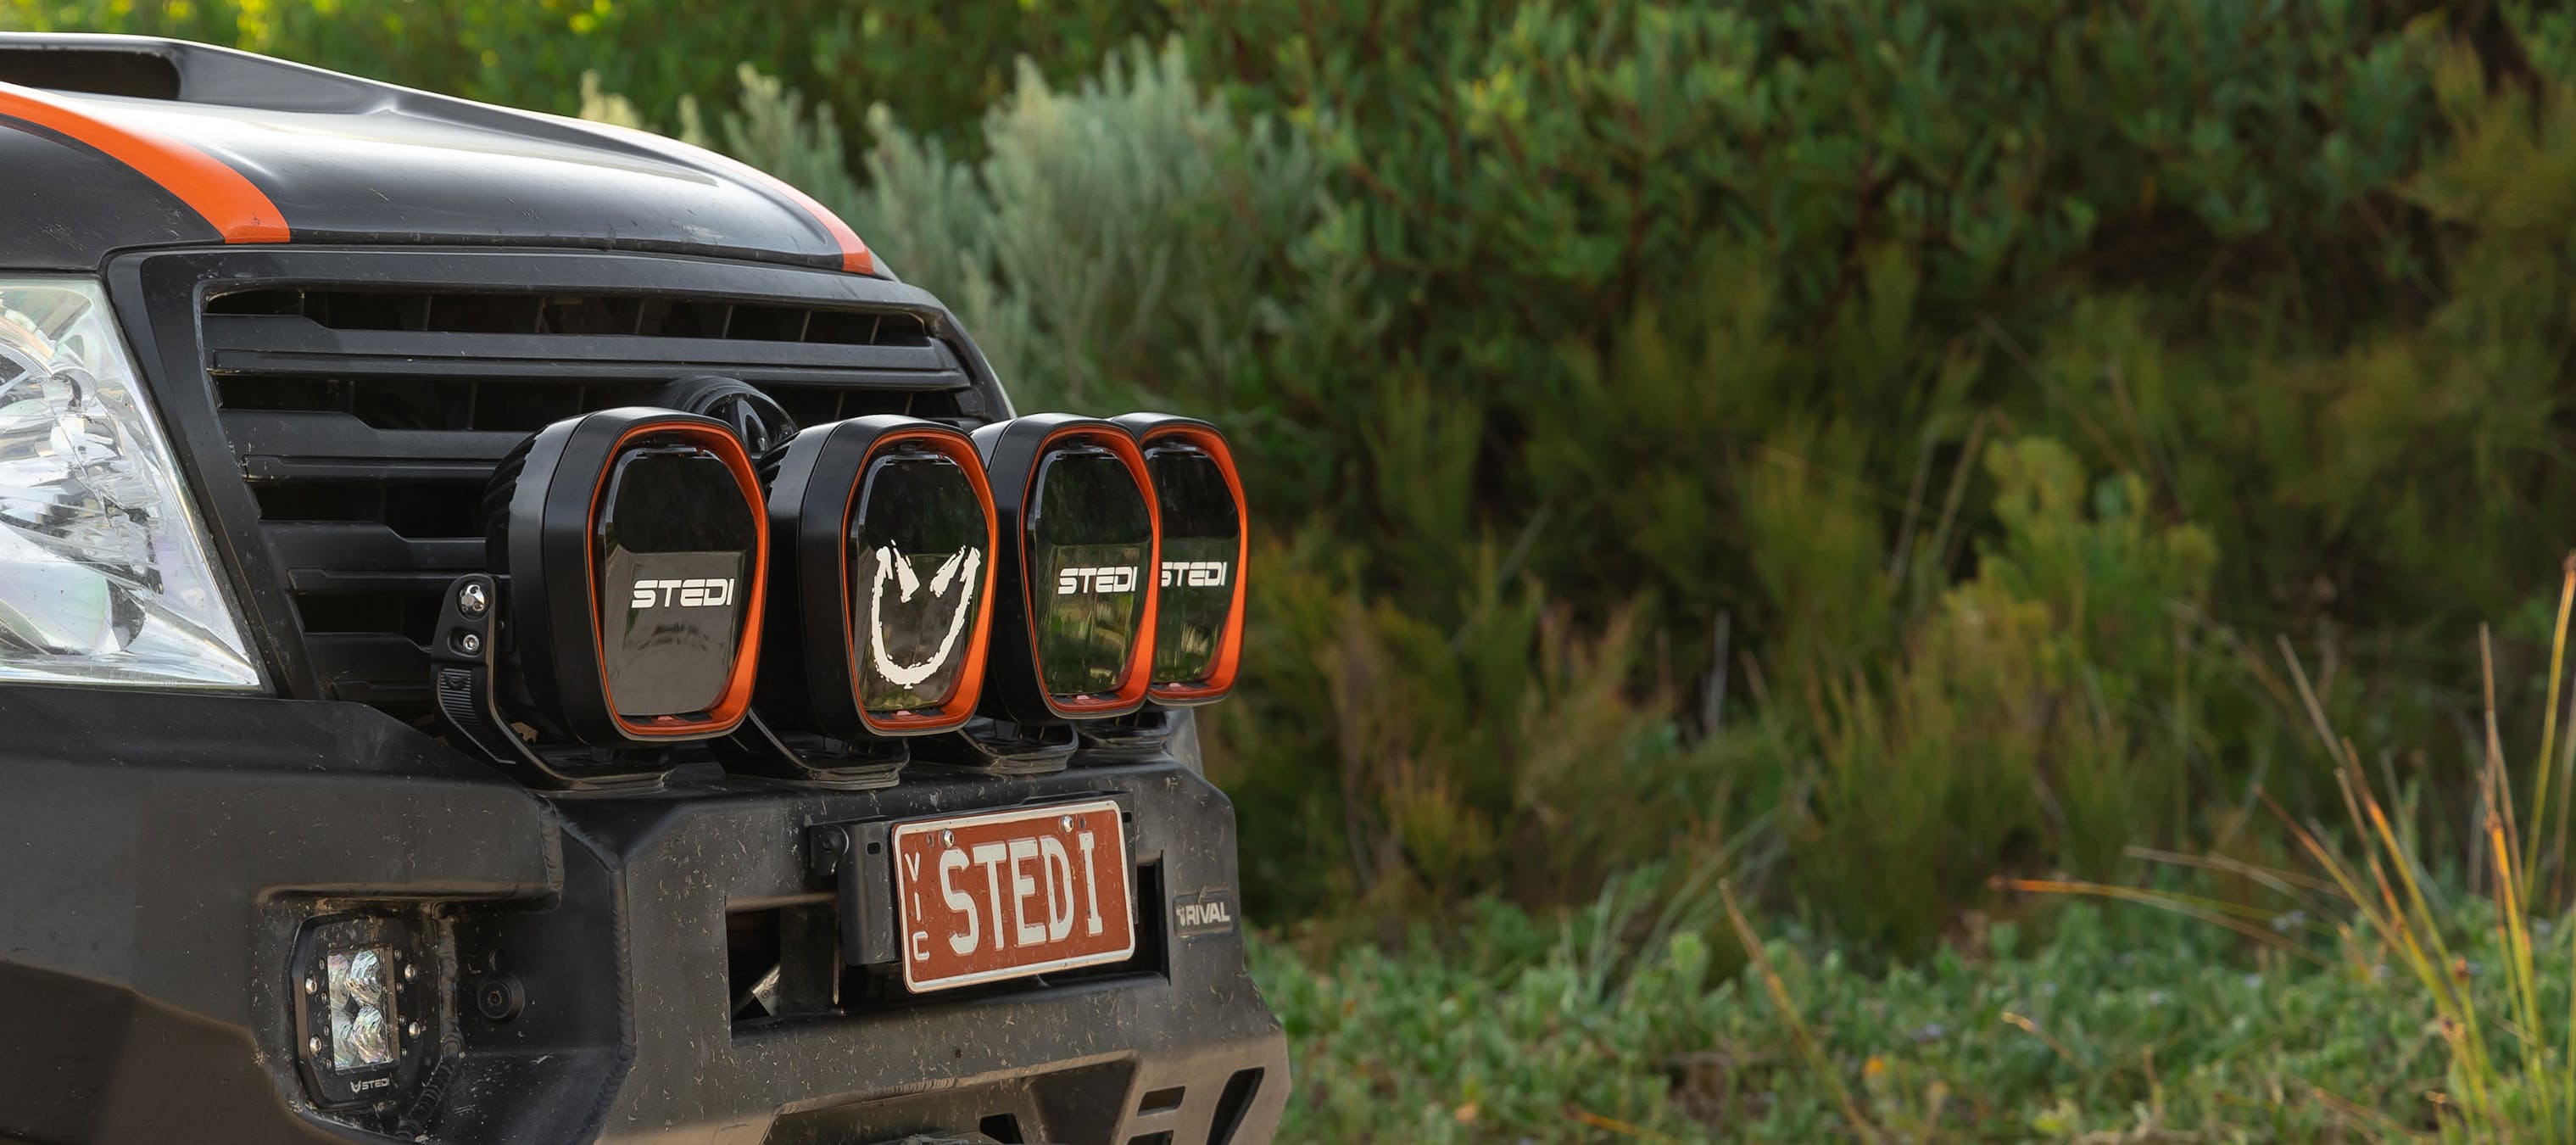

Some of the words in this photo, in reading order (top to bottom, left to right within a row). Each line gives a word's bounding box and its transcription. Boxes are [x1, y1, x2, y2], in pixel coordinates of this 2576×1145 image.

[631, 578, 735, 608] STEDI
[1057, 567, 1138, 594] STEDI
[904, 851, 930, 961] VIC
[940, 832, 1102, 956] STEDI
[361, 1077, 390, 1091] STEDI
